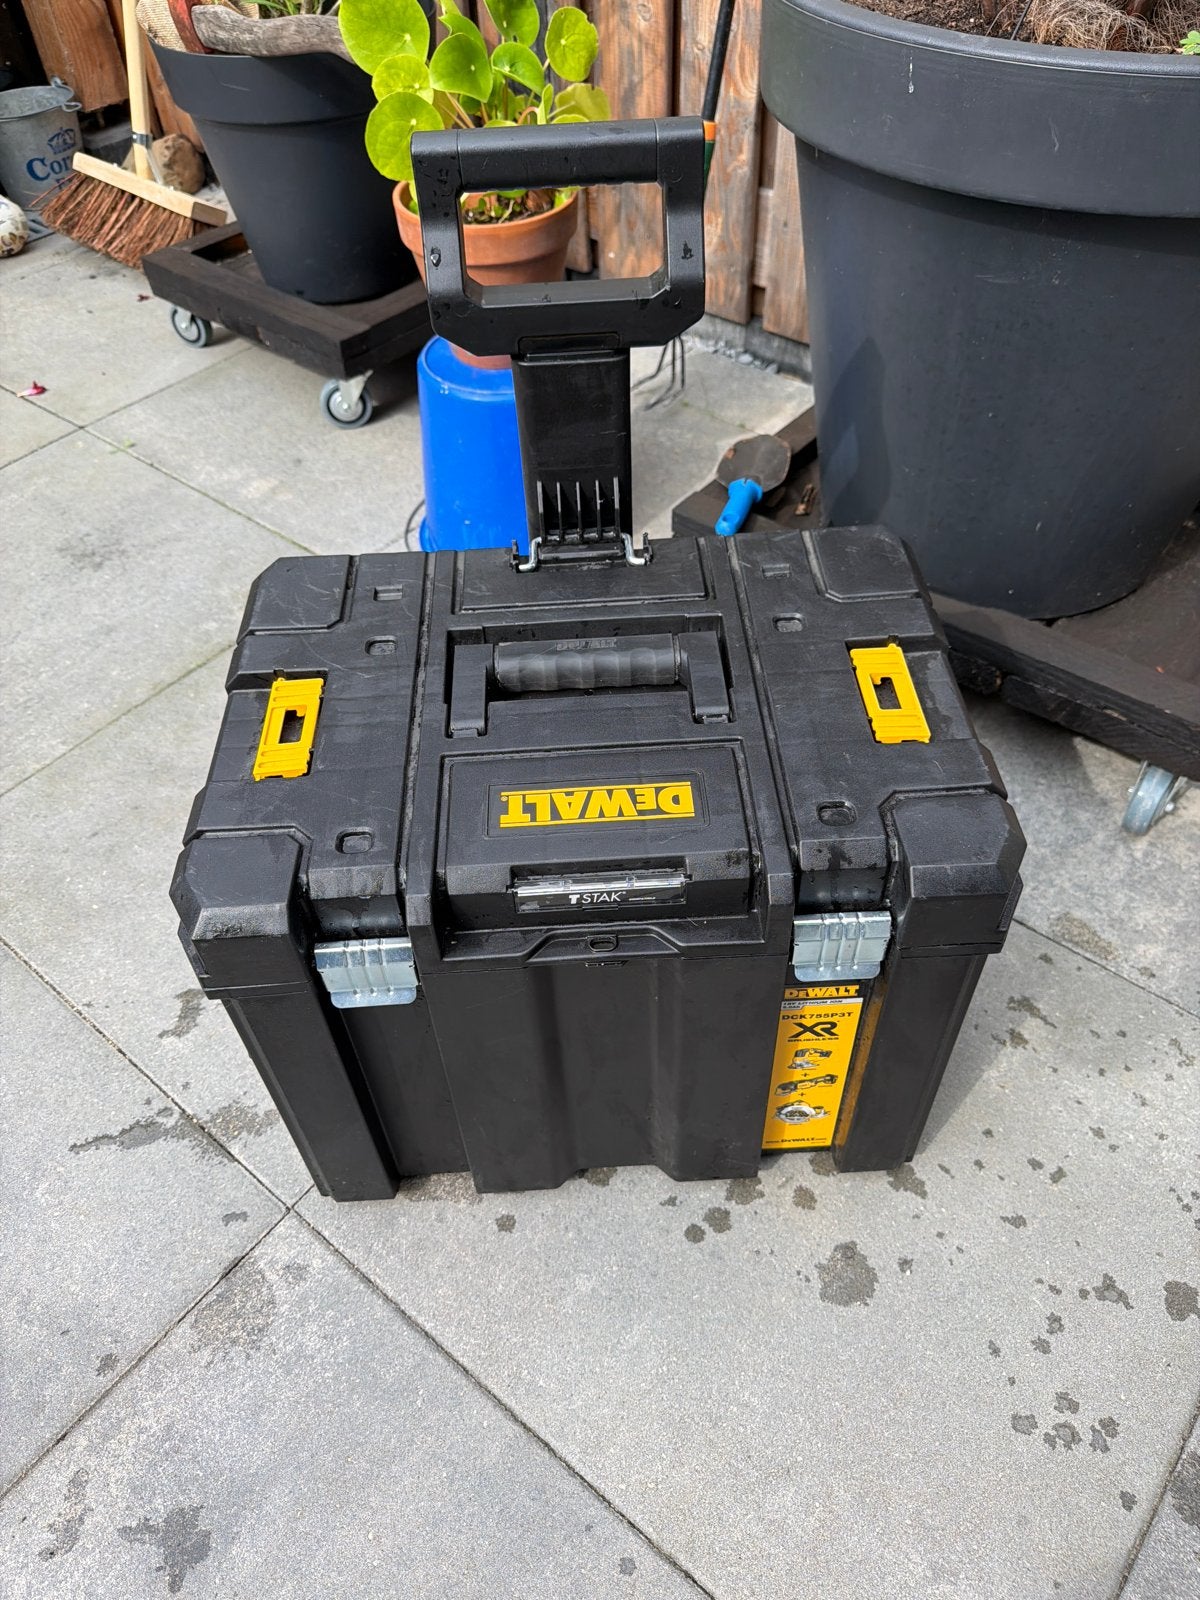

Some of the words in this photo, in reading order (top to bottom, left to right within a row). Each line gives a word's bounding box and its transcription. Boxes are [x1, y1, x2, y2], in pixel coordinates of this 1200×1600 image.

[500, 785, 694, 824] DEWALT
[784, 985, 859, 999] DEWALT
[782, 1011, 854, 1020] DCK755P3T
[788, 1021, 839, 1038] XR
